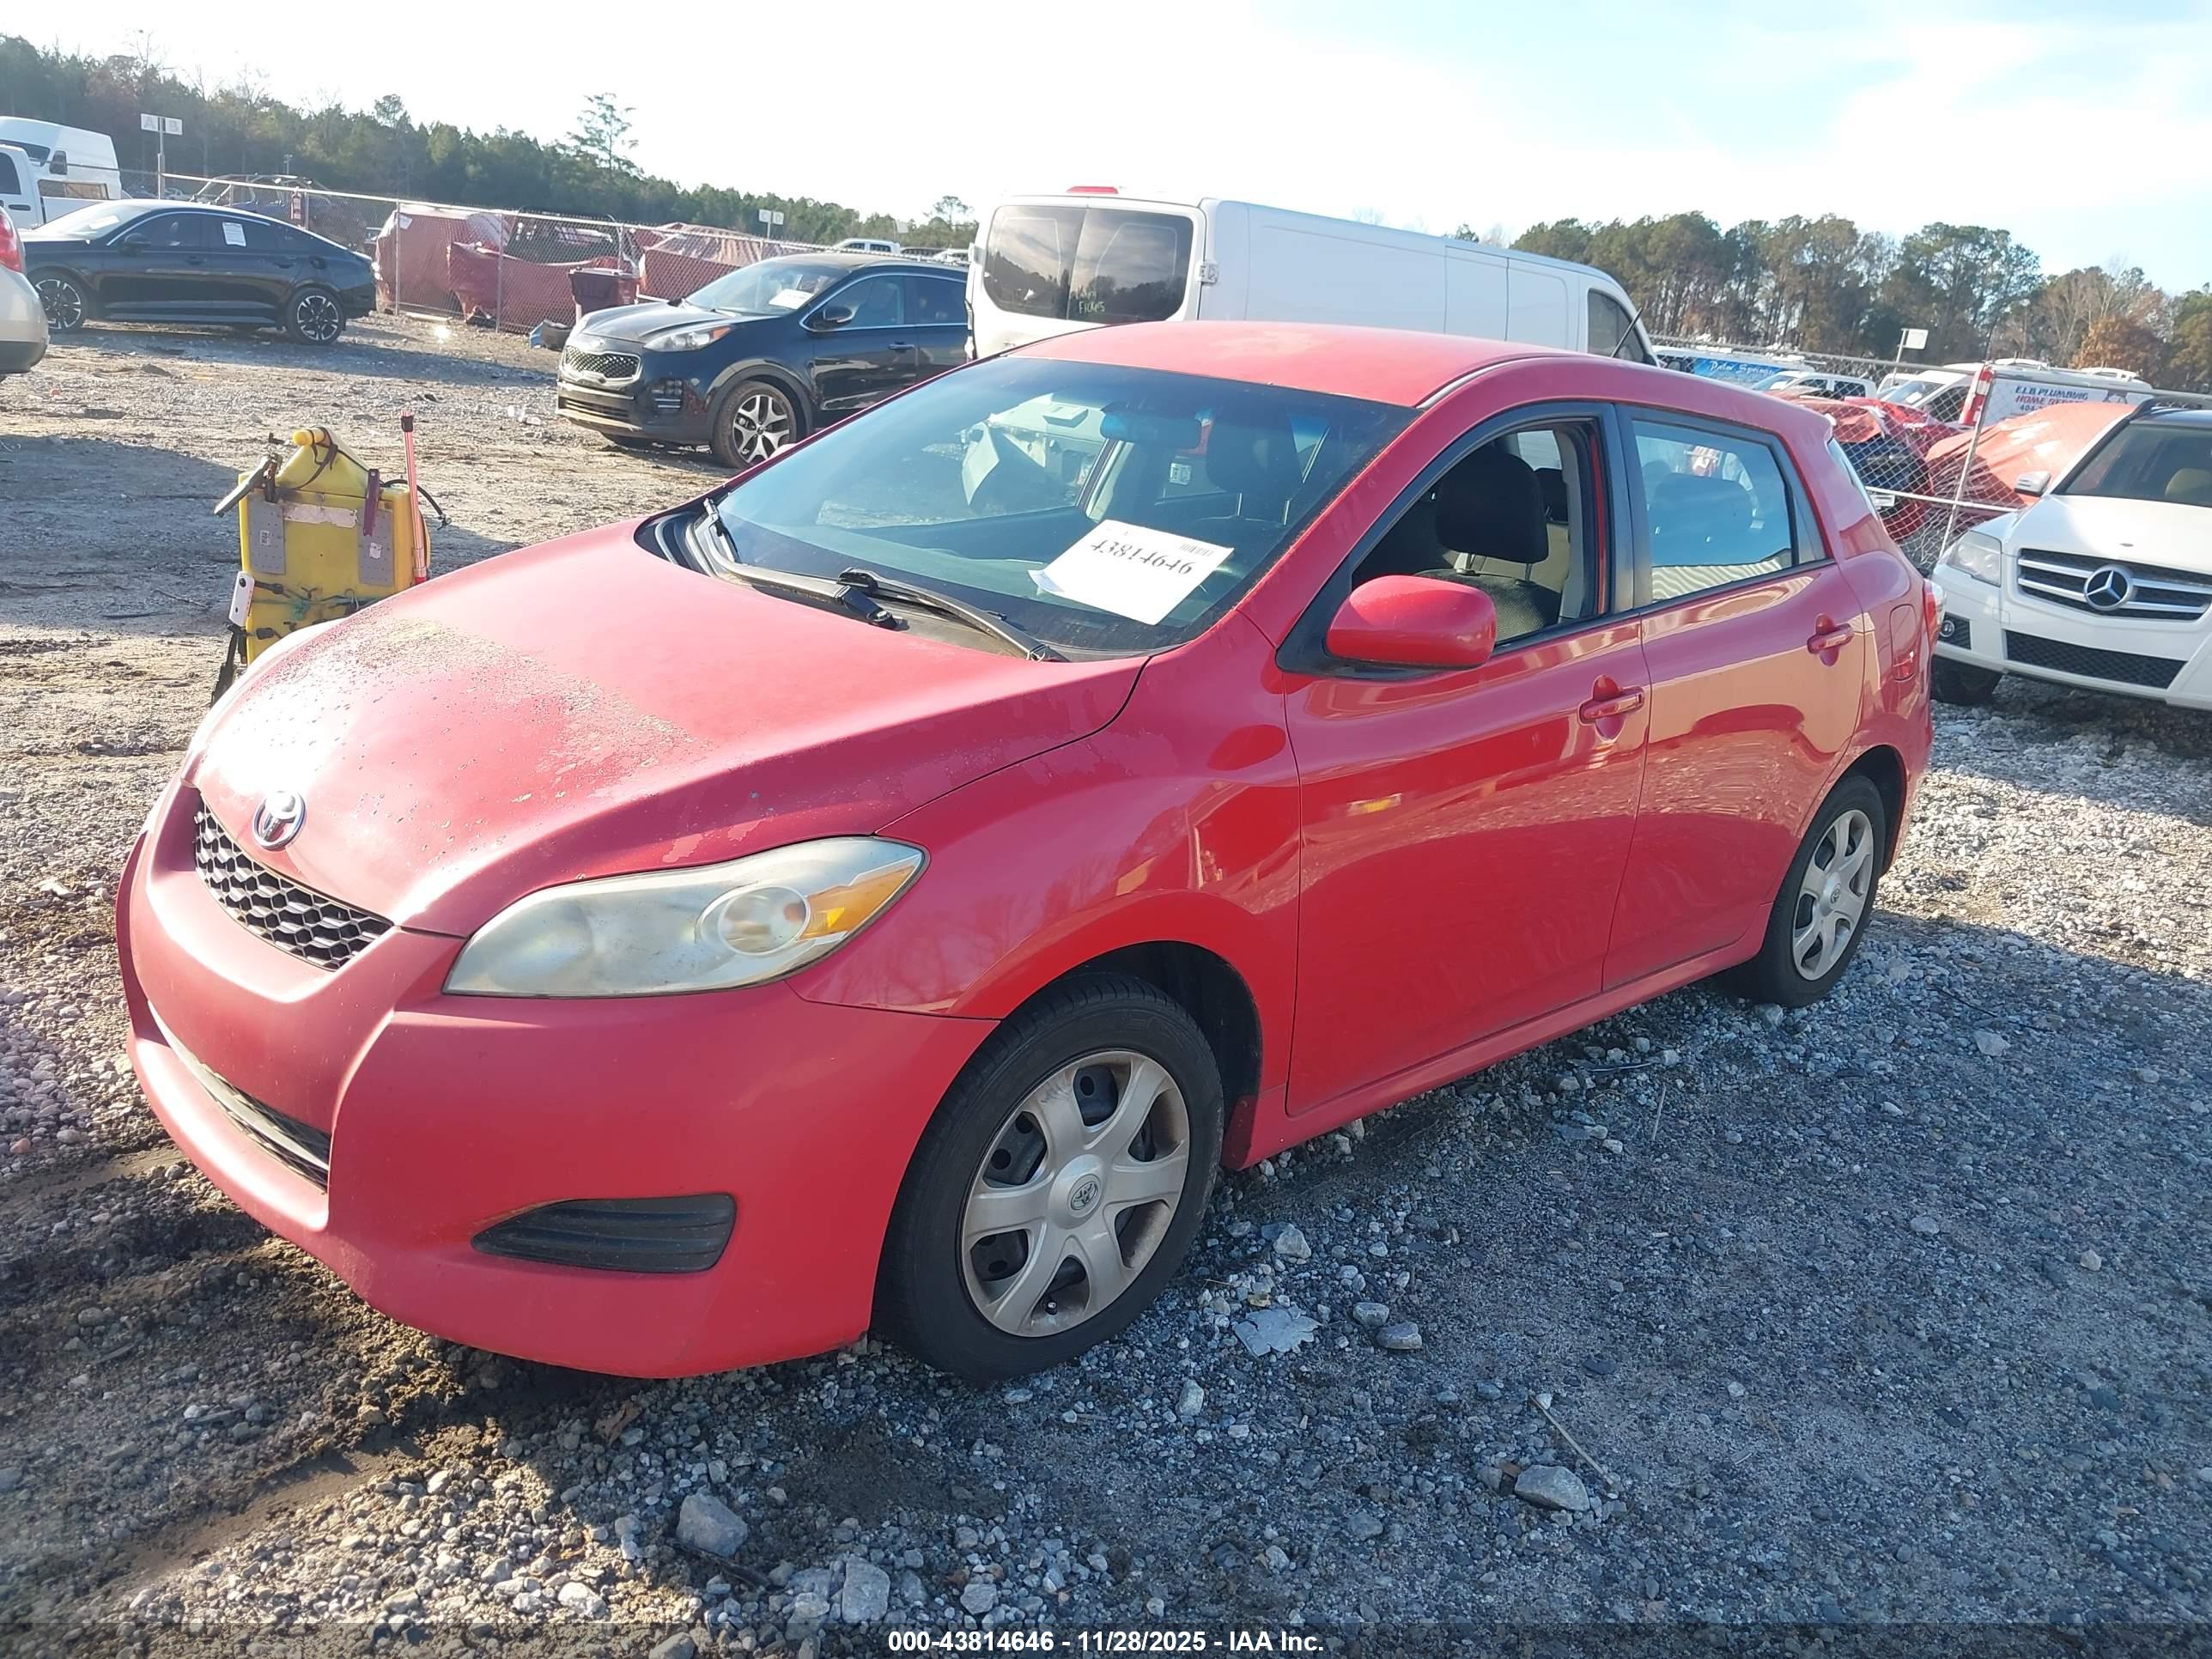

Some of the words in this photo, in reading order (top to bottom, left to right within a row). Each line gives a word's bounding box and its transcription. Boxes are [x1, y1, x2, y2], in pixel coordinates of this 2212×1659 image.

[2015, 395, 2045, 405] HOME
[2038, 388, 2088, 400] PLUMBING
[1090, 539, 1198, 575] 43814646
